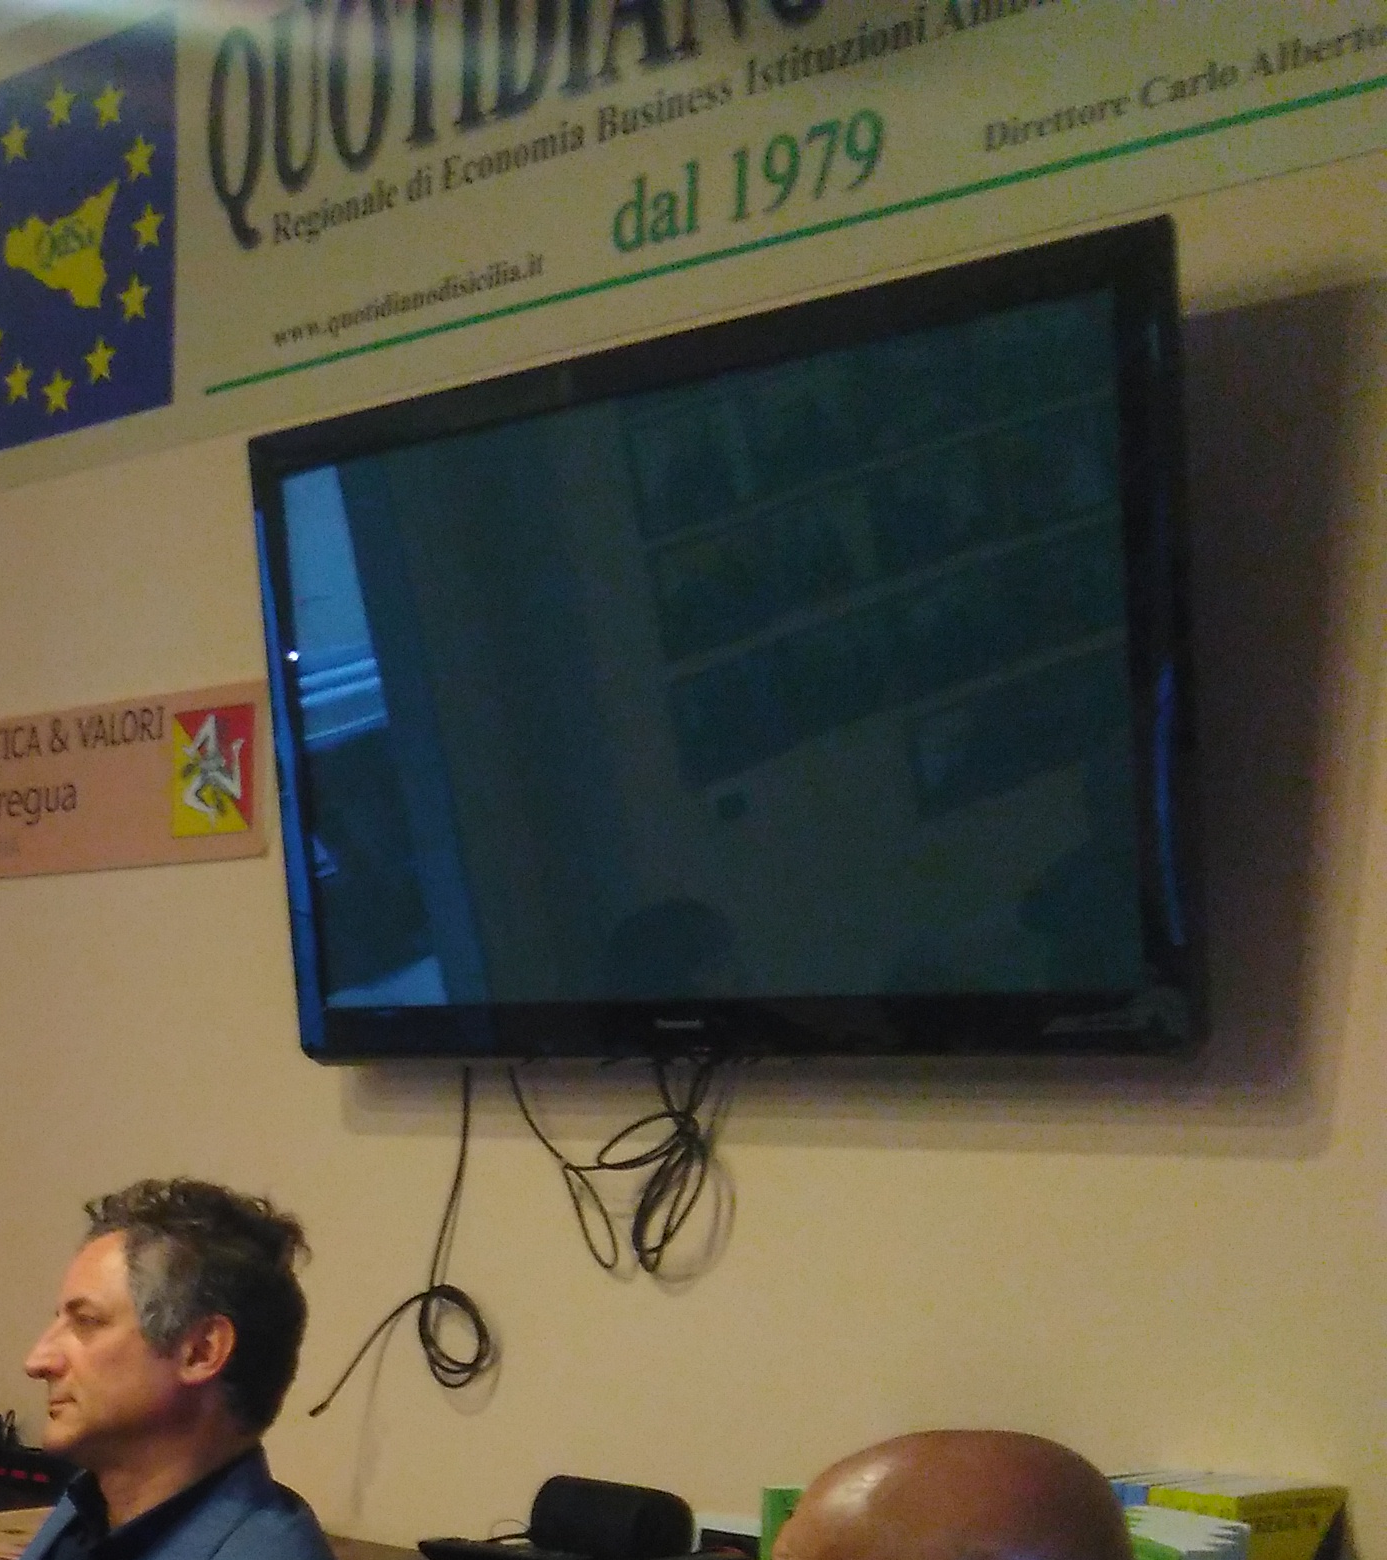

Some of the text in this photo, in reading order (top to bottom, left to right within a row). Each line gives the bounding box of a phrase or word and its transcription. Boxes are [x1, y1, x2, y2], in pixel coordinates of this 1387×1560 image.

[208, 0, 831, 249] QUOTIDI
[271, 177, 400, 245] Regionale
[405, 166, 435, 203] di
[441, 119, 585, 193] Economia
[596, 79, 733, 145] Business
[745, 5, 929, 96] Istituzioni
[984, 22, 1387, 152] Direttore Carlo Alberto
[611, 107, 886, 254] dal 1979
[271, 252, 545, 348] www.quotidianodisicilia.it
[50, 716, 69, 753] &
[76, 704, 166, 749] VALORI
